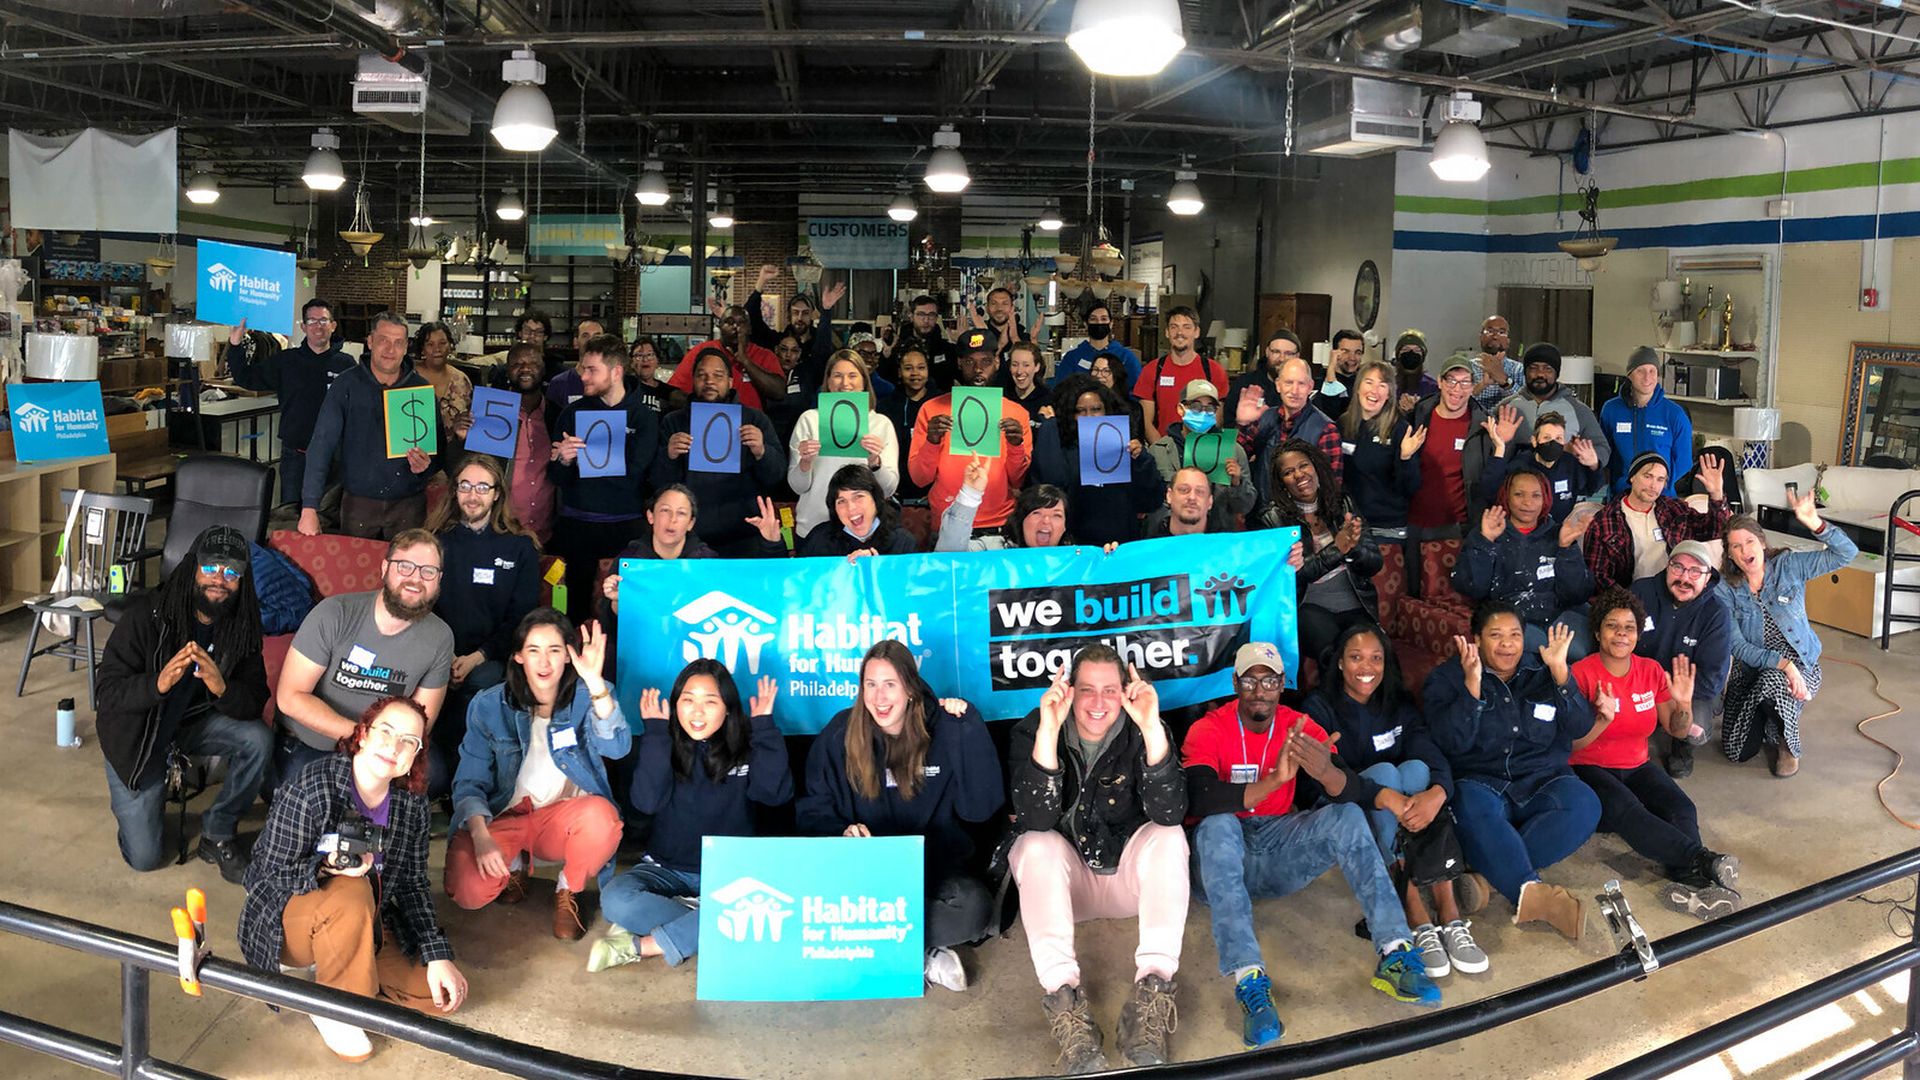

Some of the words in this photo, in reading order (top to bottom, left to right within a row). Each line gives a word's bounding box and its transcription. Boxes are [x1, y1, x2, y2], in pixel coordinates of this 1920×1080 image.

[808, 222, 908, 237] CUSTOMERS
[239, 274, 281, 293] Habitat
[52, 409, 98, 423] Habitat
[402, 393, 428, 444] $
[484, 402, 514, 441] 5
[830, 399, 861, 449] 0
[958, 395, 989, 447] 0
[702, 412, 733, 464] 0
[1094, 422, 1124, 474] 0
[997, 599, 1062, 628] we
[1075, 580, 1179, 625] build
[788, 613, 923, 650] Habitat
[341, 661, 359, 674] we
[789, 653, 818, 673] for
[1000, 635, 1198, 681] togher.
[336, 672, 388, 692] together.
[790, 680, 859, 700] Philadelp
[802, 896, 907, 923] Habitat
[802, 926, 826, 941] for
[830, 925, 907, 943] Humanity
